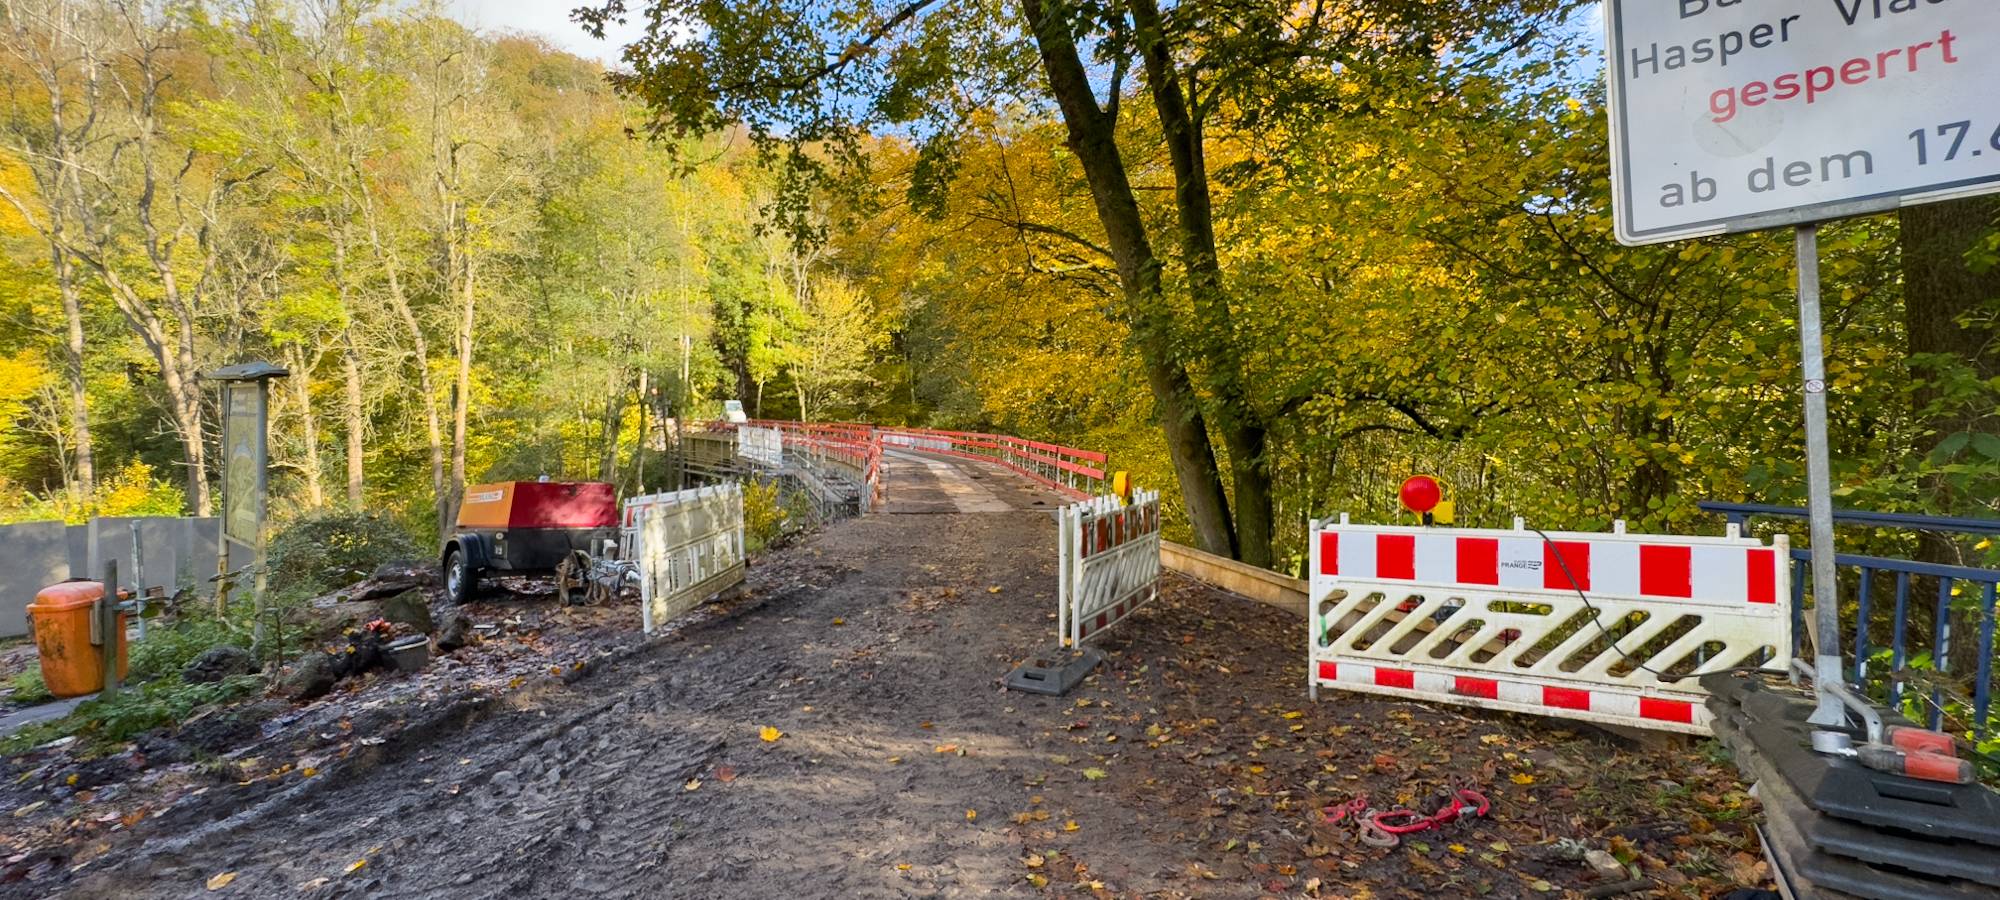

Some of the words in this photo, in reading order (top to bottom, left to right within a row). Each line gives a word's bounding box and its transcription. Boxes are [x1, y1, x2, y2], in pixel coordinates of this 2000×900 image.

[1632, 15, 1799, 79] Hasper
[1709, 30, 1958, 123] gesperrt
[1659, 171, 1717, 208] ab
[1747, 149, 1873, 193] dem
